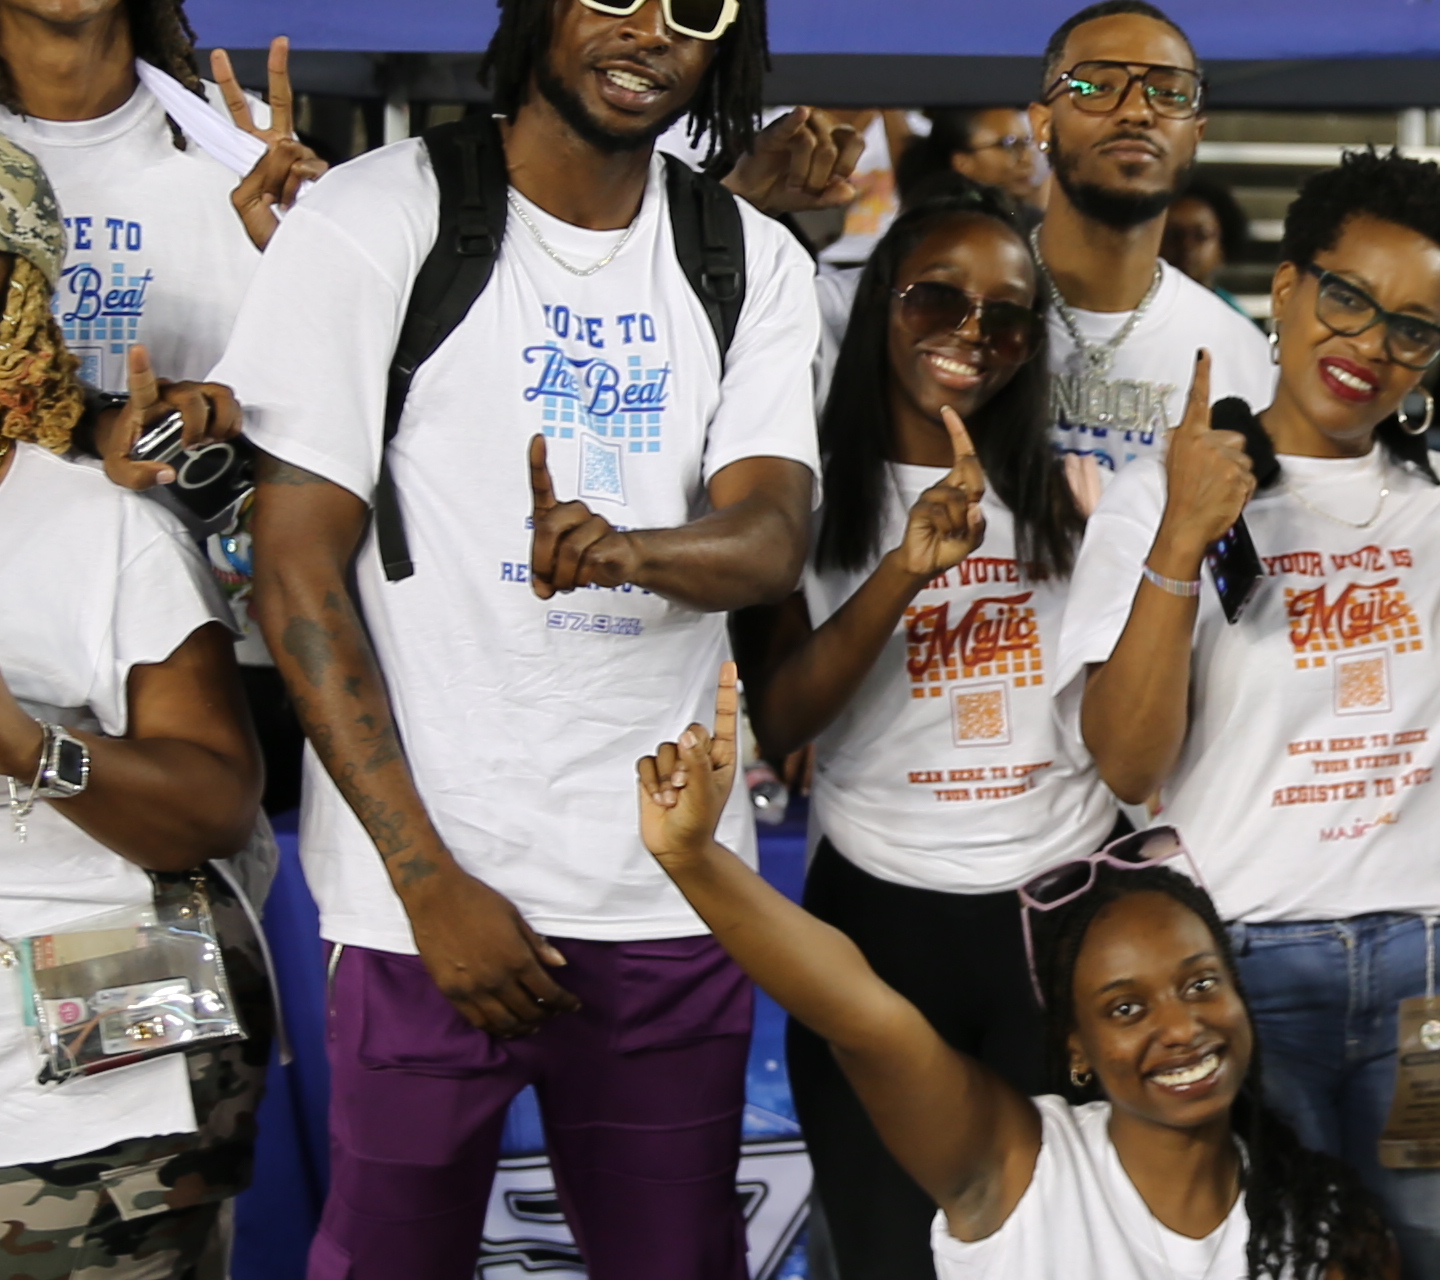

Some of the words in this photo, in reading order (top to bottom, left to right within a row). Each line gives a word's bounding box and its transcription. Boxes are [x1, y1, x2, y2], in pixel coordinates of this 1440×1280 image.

[105, 217, 142, 250] TO
[616, 313, 657, 344] TO
[583, 360, 673, 418] Beat
[1262, 551, 1325, 578] YOUR
[1271, 779, 1366, 808] REGISTER
